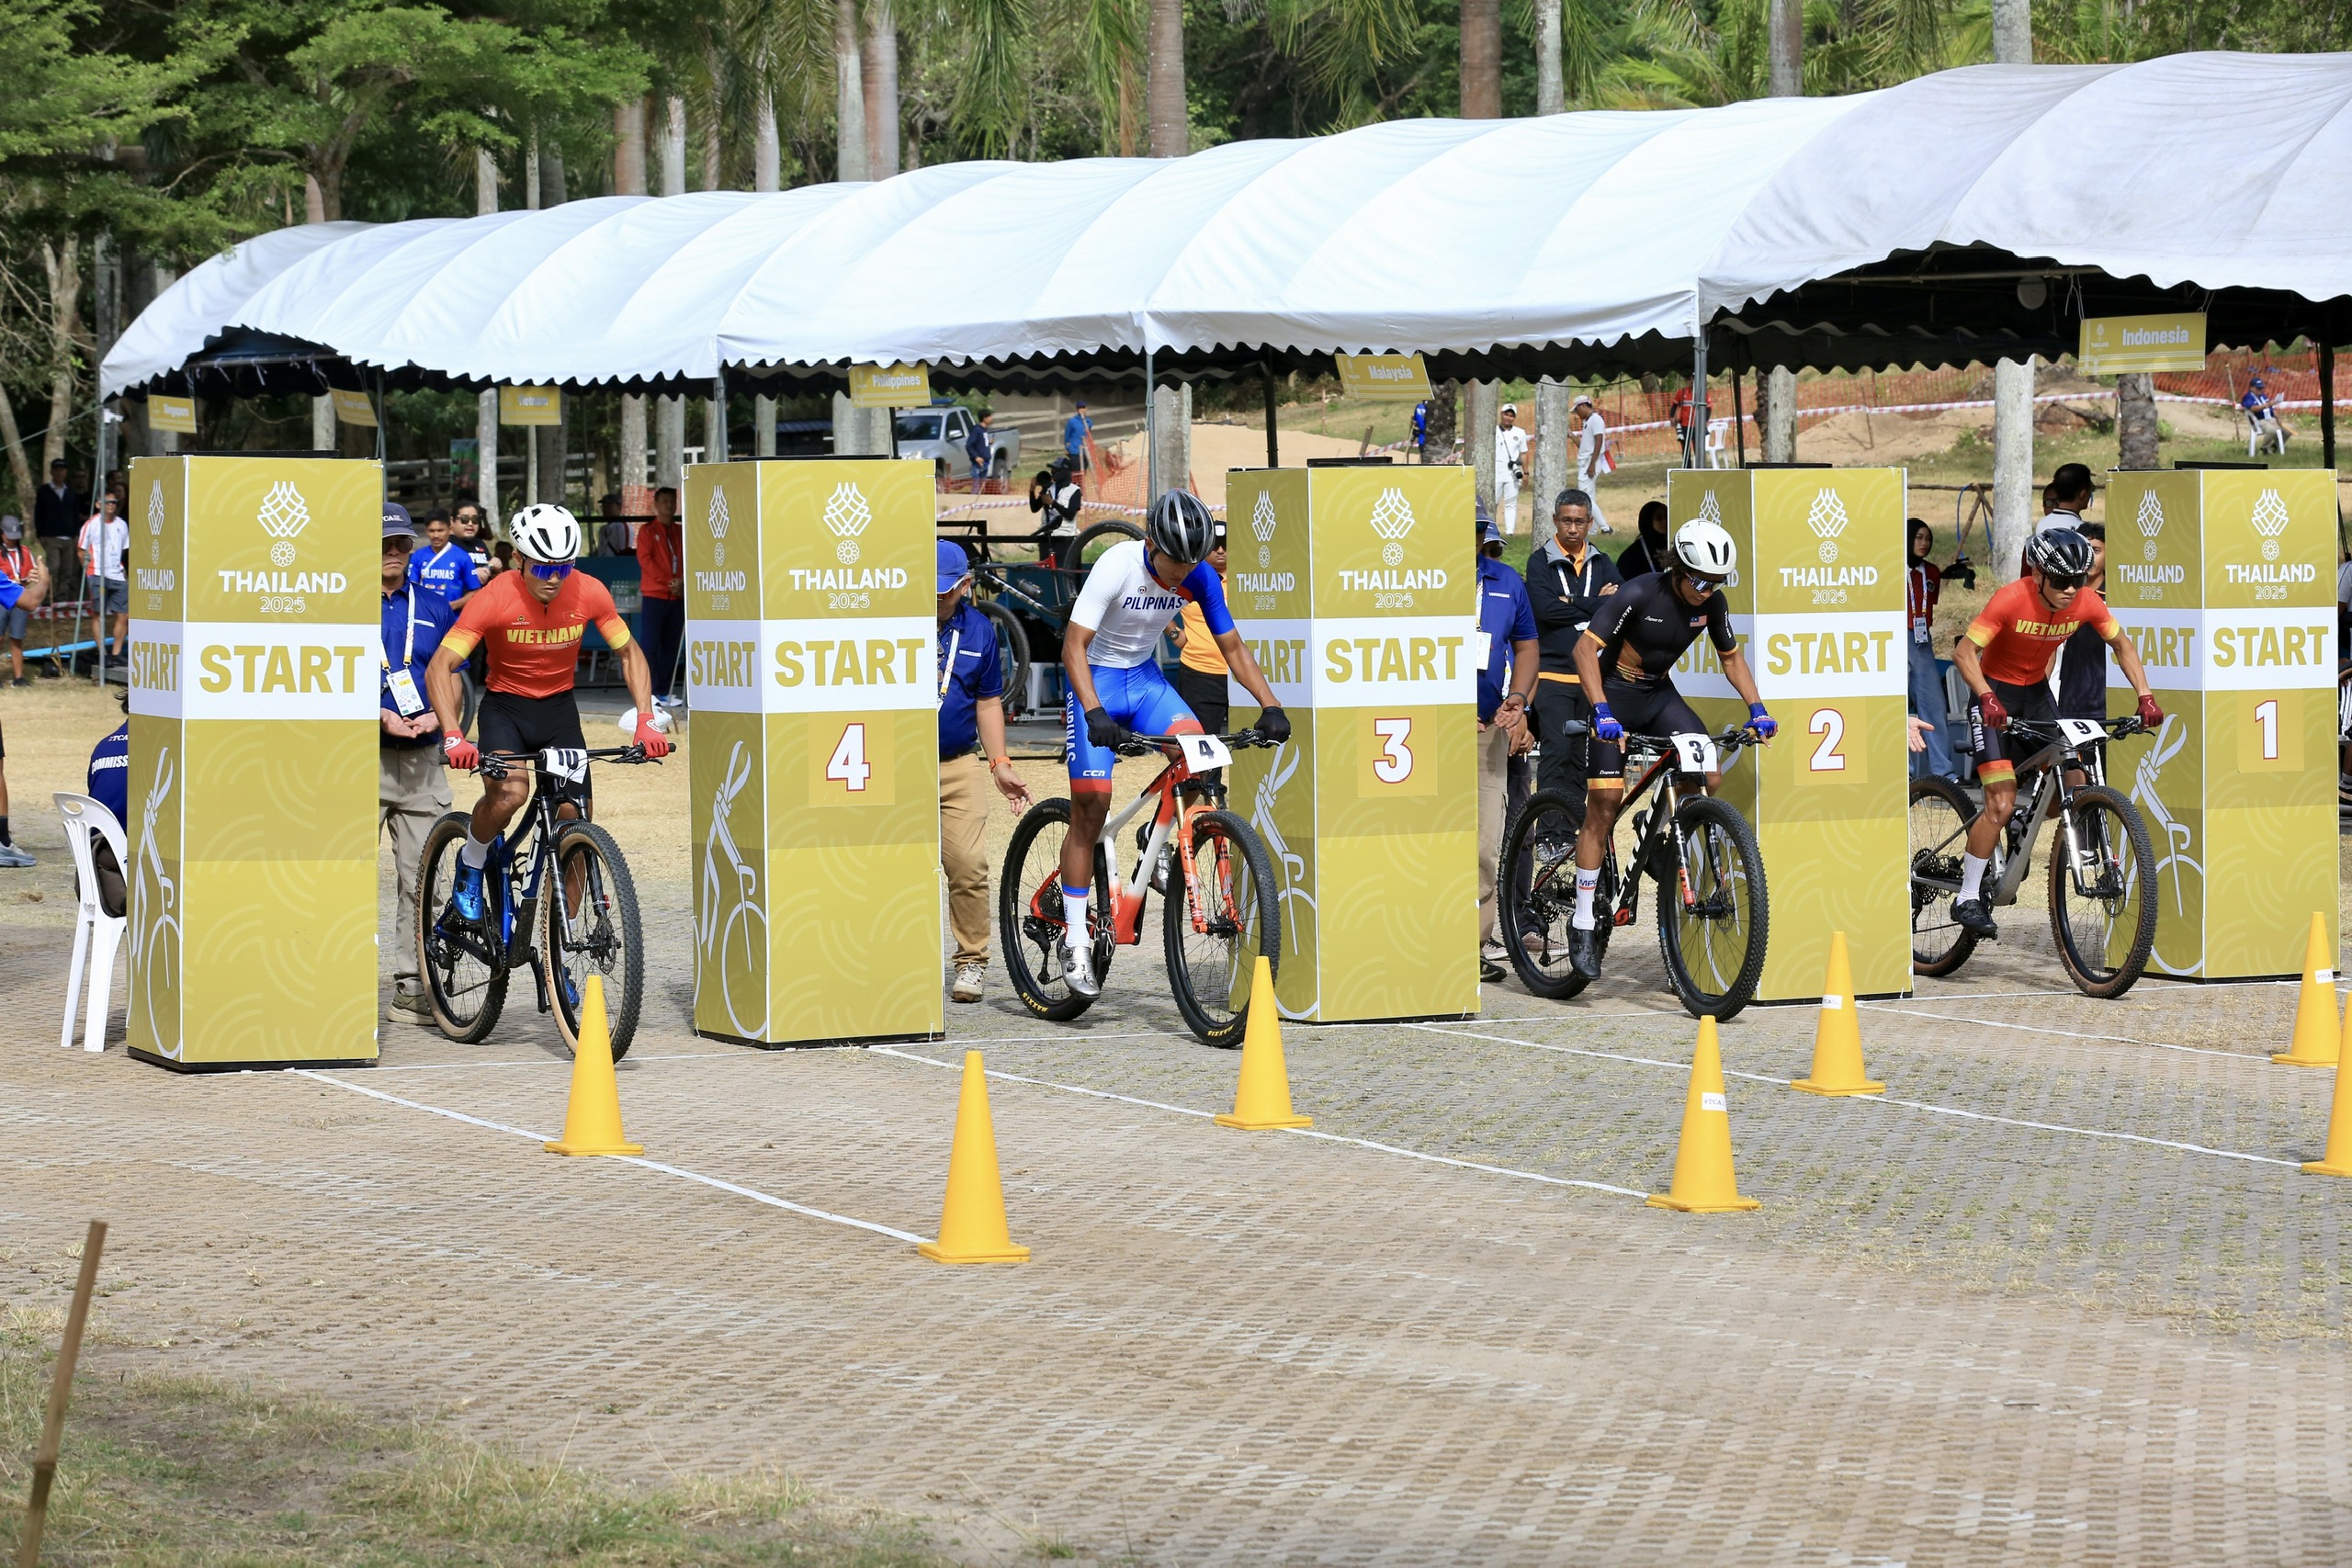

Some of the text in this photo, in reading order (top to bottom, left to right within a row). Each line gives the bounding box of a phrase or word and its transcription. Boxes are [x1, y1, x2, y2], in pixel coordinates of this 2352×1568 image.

[2122, 325, 2189, 346] Indonesia
[872, 373, 922, 389] Philippines
[1367, 365, 1414, 383] Malaysia
[136, 569, 175, 592] THAILAND
[218, 570, 347, 593] THAILAND
[695, 570, 746, 592] THAILAND
[788, 568, 908, 591] THAILAND
[1236, 572, 1295, 592] THAILAND
[1338, 569, 1448, 591] THAILAND
[1779, 566, 1878, 588] THAILAND
[2118, 564, 2185, 583] THAILAND
[2224, 563, 2316, 583] THAILAND
[147, 593, 162, 611] 2025
[711, 594, 730, 611] 2025
[828, 592, 871, 610] 2025
[1122, 596, 1185, 610] PILIPINAS
[1254, 594, 1276, 611] 2025
[1374, 592, 1413, 609] 2025
[1811, 589, 1848, 604] 2025
[2139, 585, 2163, 601] 2025
[2254, 585, 2288, 600] 2025
[259, 596, 306, 614] 2025
[506, 622, 584, 644] VIETNAM
[2015, 615, 2081, 637] VIETNAM
[1767, 631, 1894, 676] START
[2110, 626, 2196, 668] TART
[2212, 626, 2329, 668] START
[131, 640, 180, 692] START
[198, 644, 366, 694] START
[690, 640, 755, 688] START
[775, 638, 925, 687] START
[1232, 639, 1306, 683] TART
[1325, 636, 1464, 683] START
[2073, 721, 2092, 735] 9
[2255, 699, 2278, 760] 1
[1198, 739, 1215, 760] 4
[1373, 717, 1414, 784] 3
[1809, 707, 1846, 772] 2
[826, 722, 871, 792] 4
[1689, 740, 1705, 763] 3
[91, 754, 129, 775] COMMISS
[1022, 992, 1049, 1012] MAXXIS
[1206, 1024, 1235, 1037] MAXXIS
